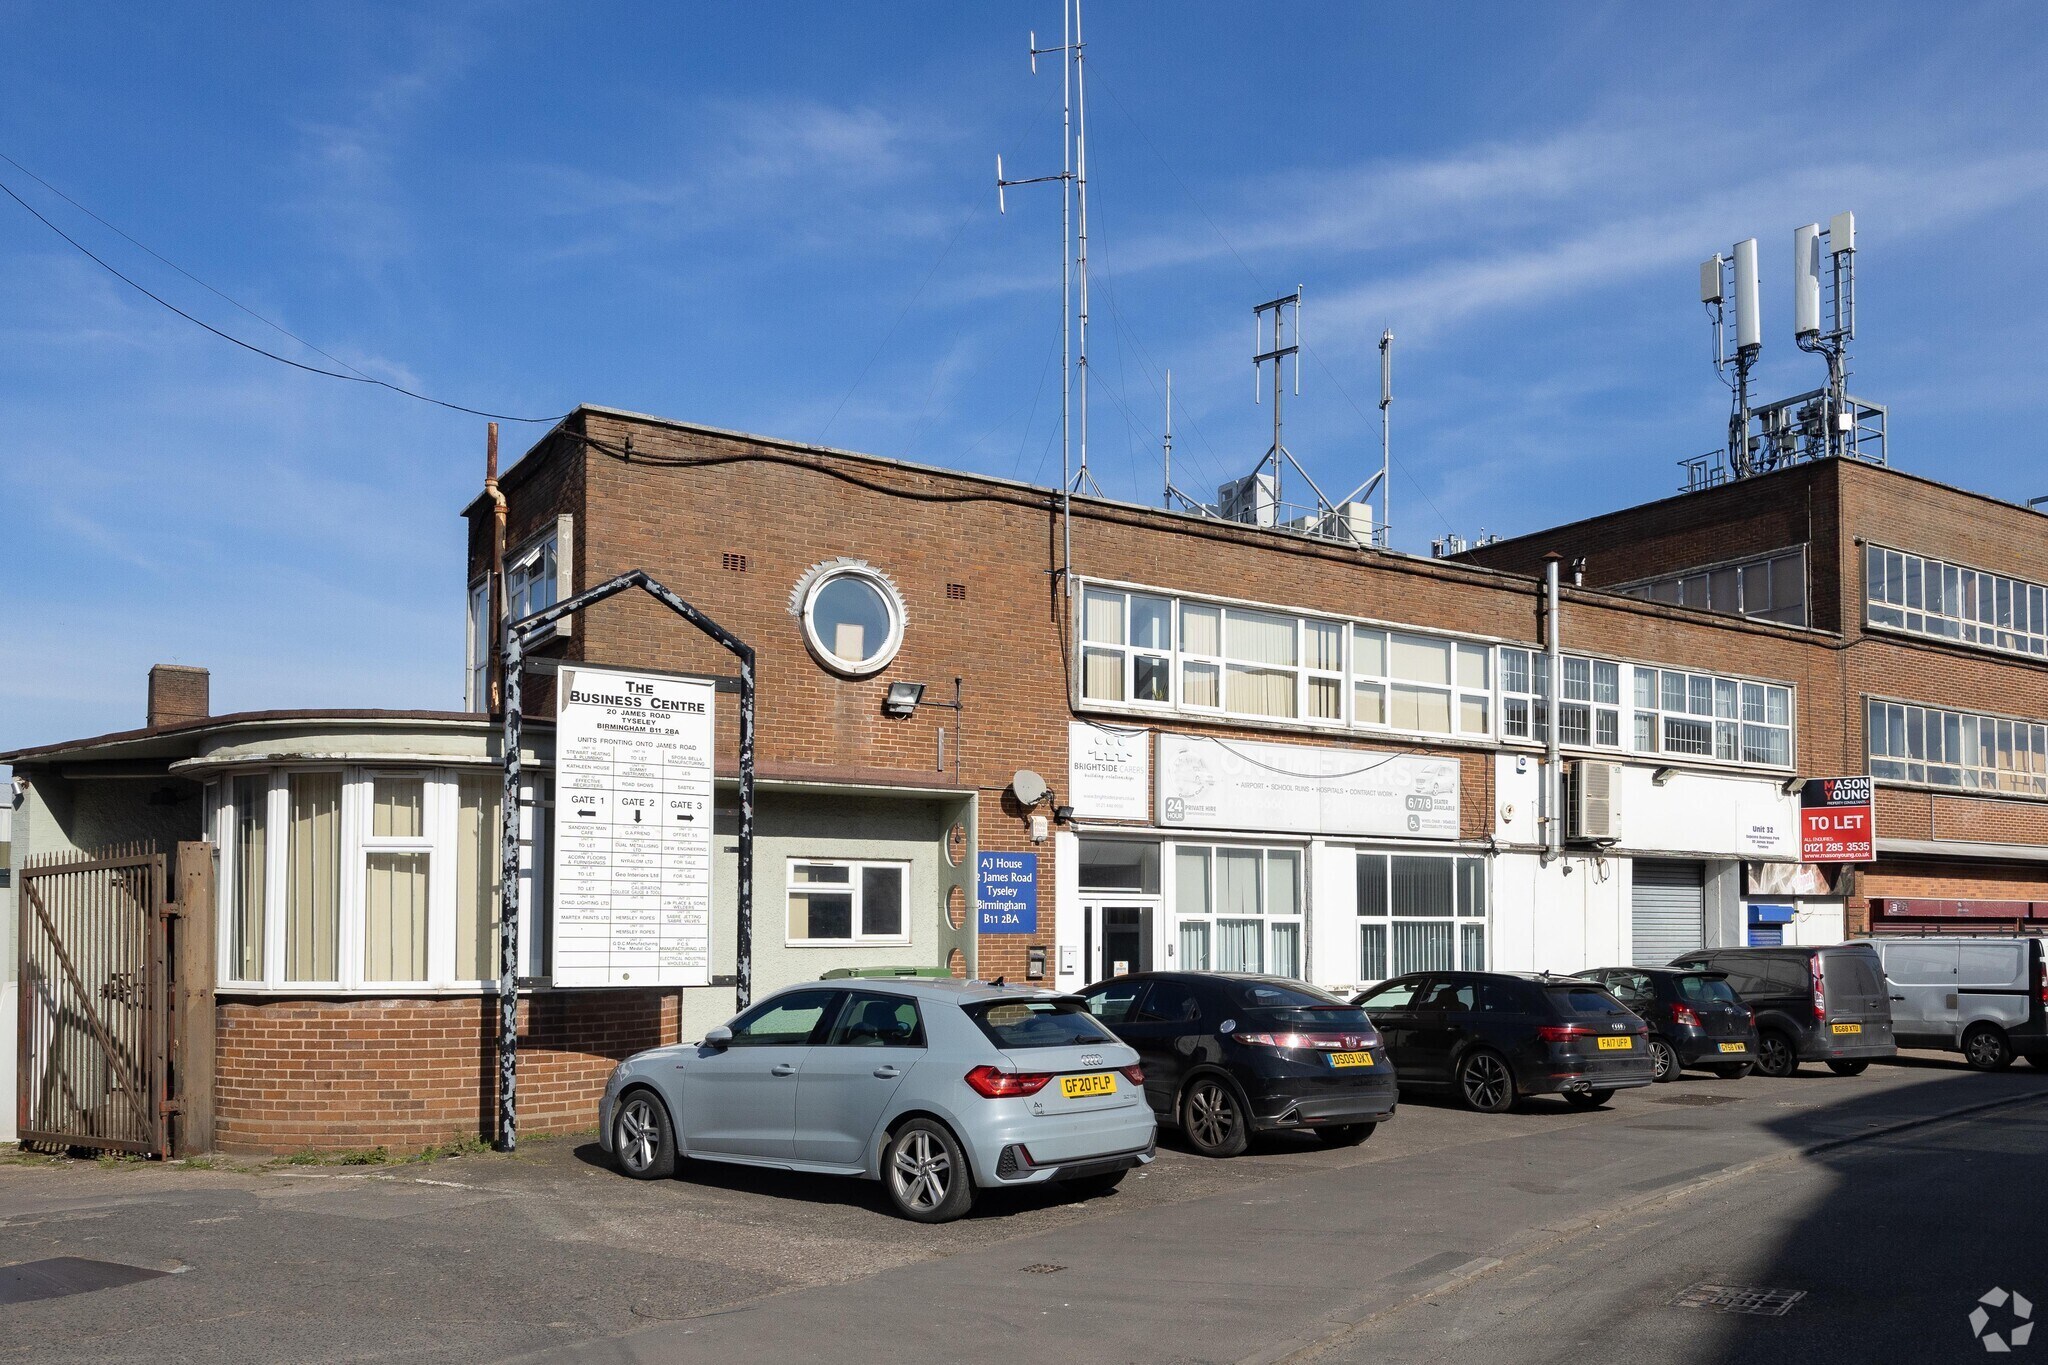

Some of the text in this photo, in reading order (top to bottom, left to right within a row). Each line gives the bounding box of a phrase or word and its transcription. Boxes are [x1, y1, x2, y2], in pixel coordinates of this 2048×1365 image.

[626, 681, 654, 694] THE
[570, 690, 705, 713] BUSINESS CENTRE
[596, 723, 646, 732] BIRMINGHAM
[622, 718, 656, 726] TYSELEY
[600, 738, 632, 746] FRONTING
[656, 742, 677, 750] JAMES
[1074, 762, 1118, 772] BRIGHTSIDE
[1824, 779, 1869, 790] MASON
[571, 796, 595, 804] GATE
[1825, 789, 1869, 800] YOUNG
[621, 798, 645, 806] GATE
[670, 801, 693, 809] GATE
[1168, 799, 1183, 812] 24
[1408, 797, 1431, 809] 6/7/8
[1808, 815, 1864, 830] TO LET
[1804, 842, 1869, 852] 0121 285 3535
[981, 858, 1022, 869] AJ House
[983, 872, 1008, 883] James
[1011, 873, 1032, 882] Road
[986, 886, 1018, 897] Tyseley
[978, 900, 1027, 911] Birmingham
[984, 914, 1019, 923] B11 2BA
[1334, 1053, 1373, 1065] DS09 UXT
[1065, 1076, 1111, 1093] GF20 FLP
